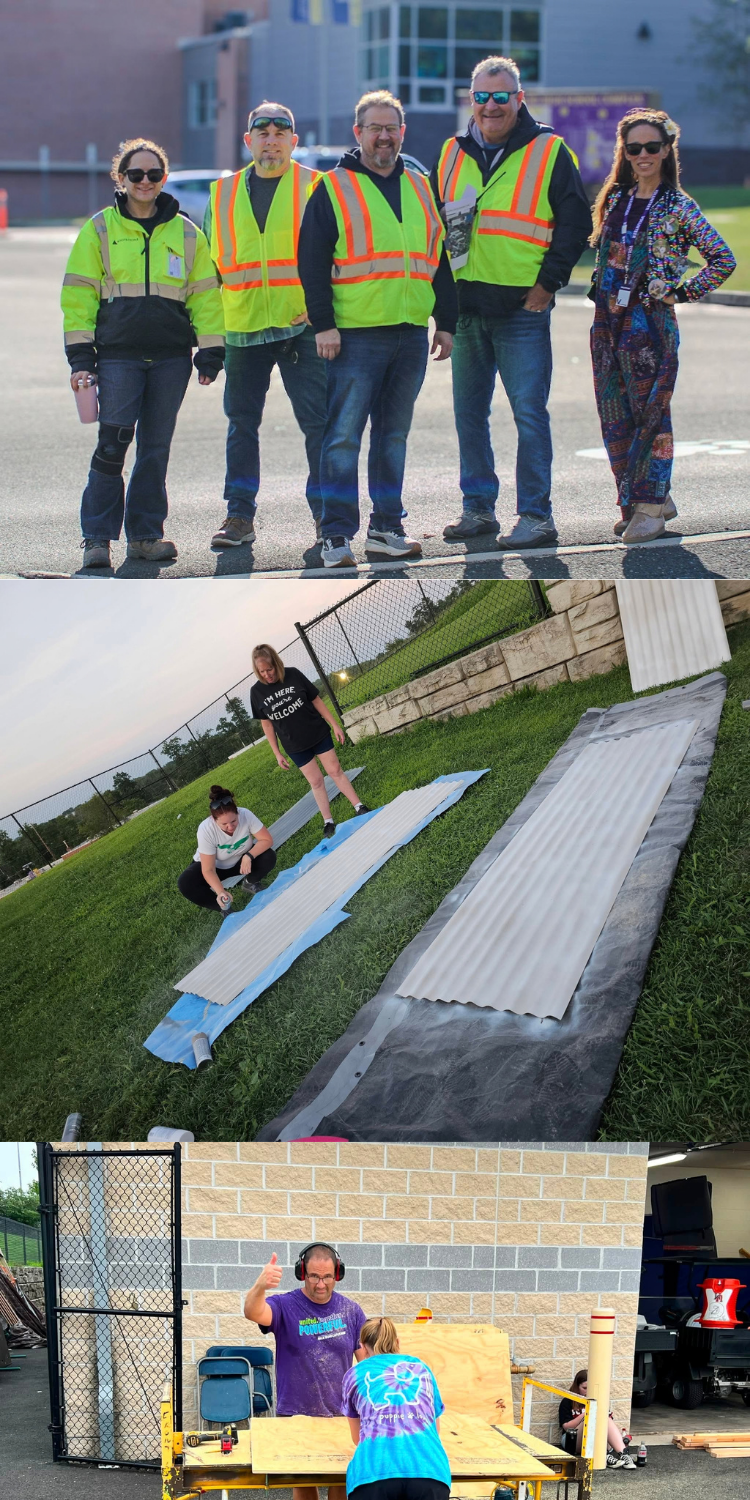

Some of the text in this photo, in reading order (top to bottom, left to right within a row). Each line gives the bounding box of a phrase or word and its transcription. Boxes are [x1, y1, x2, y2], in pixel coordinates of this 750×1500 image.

[263, 695, 274, 706] I'M
[267, 697, 304, 720] WELCOME
[379, 1411, 404, 1424] puppie
